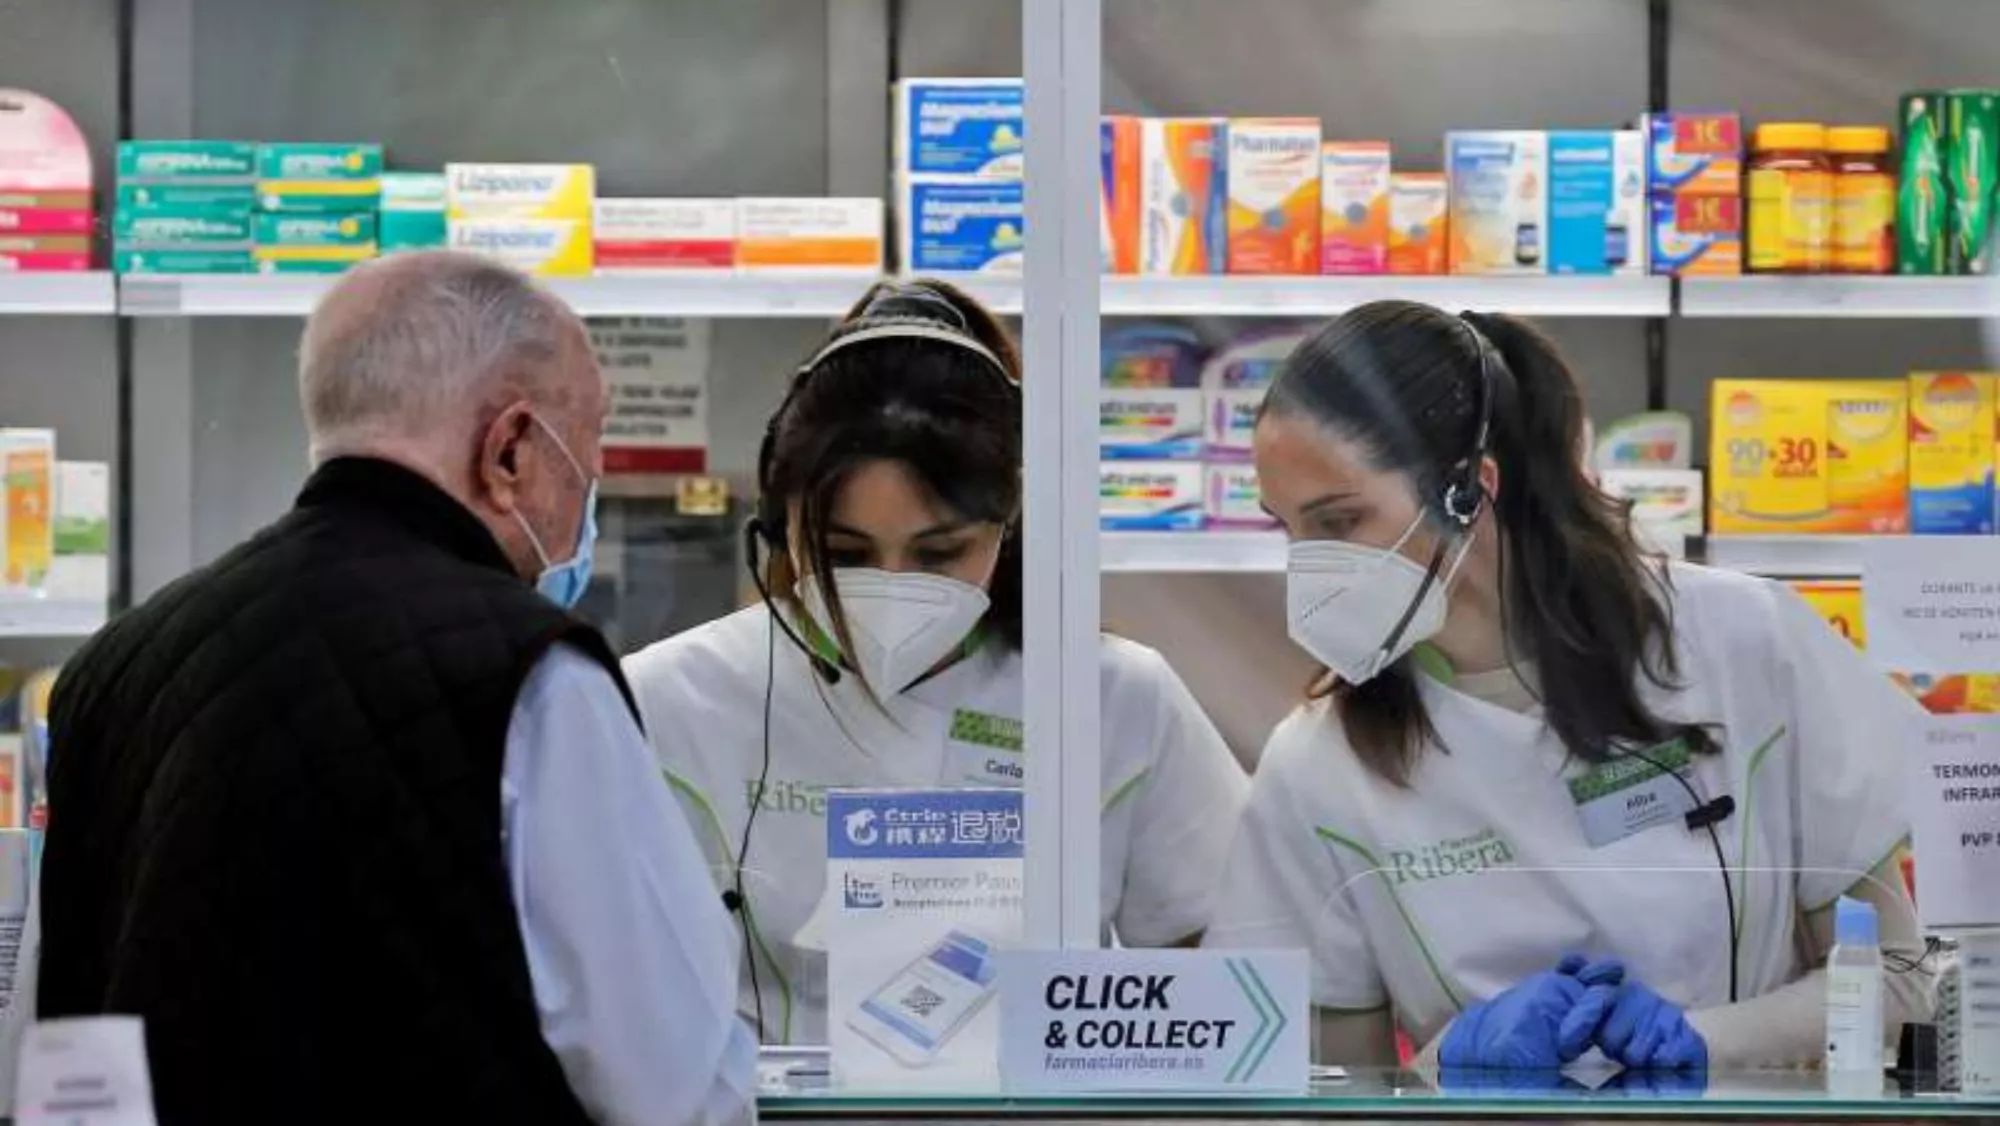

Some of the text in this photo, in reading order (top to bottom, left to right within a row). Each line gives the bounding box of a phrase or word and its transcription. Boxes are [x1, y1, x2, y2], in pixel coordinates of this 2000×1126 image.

[745, 779, 826, 816] Ribe
[1391, 839, 1514, 884] Ribera
[1044, 975, 1175, 1010] CLICK
[1044, 1020, 1235, 1049] & COLLECT
[1043, 1053, 1205, 1071] farmaciaribera.es
